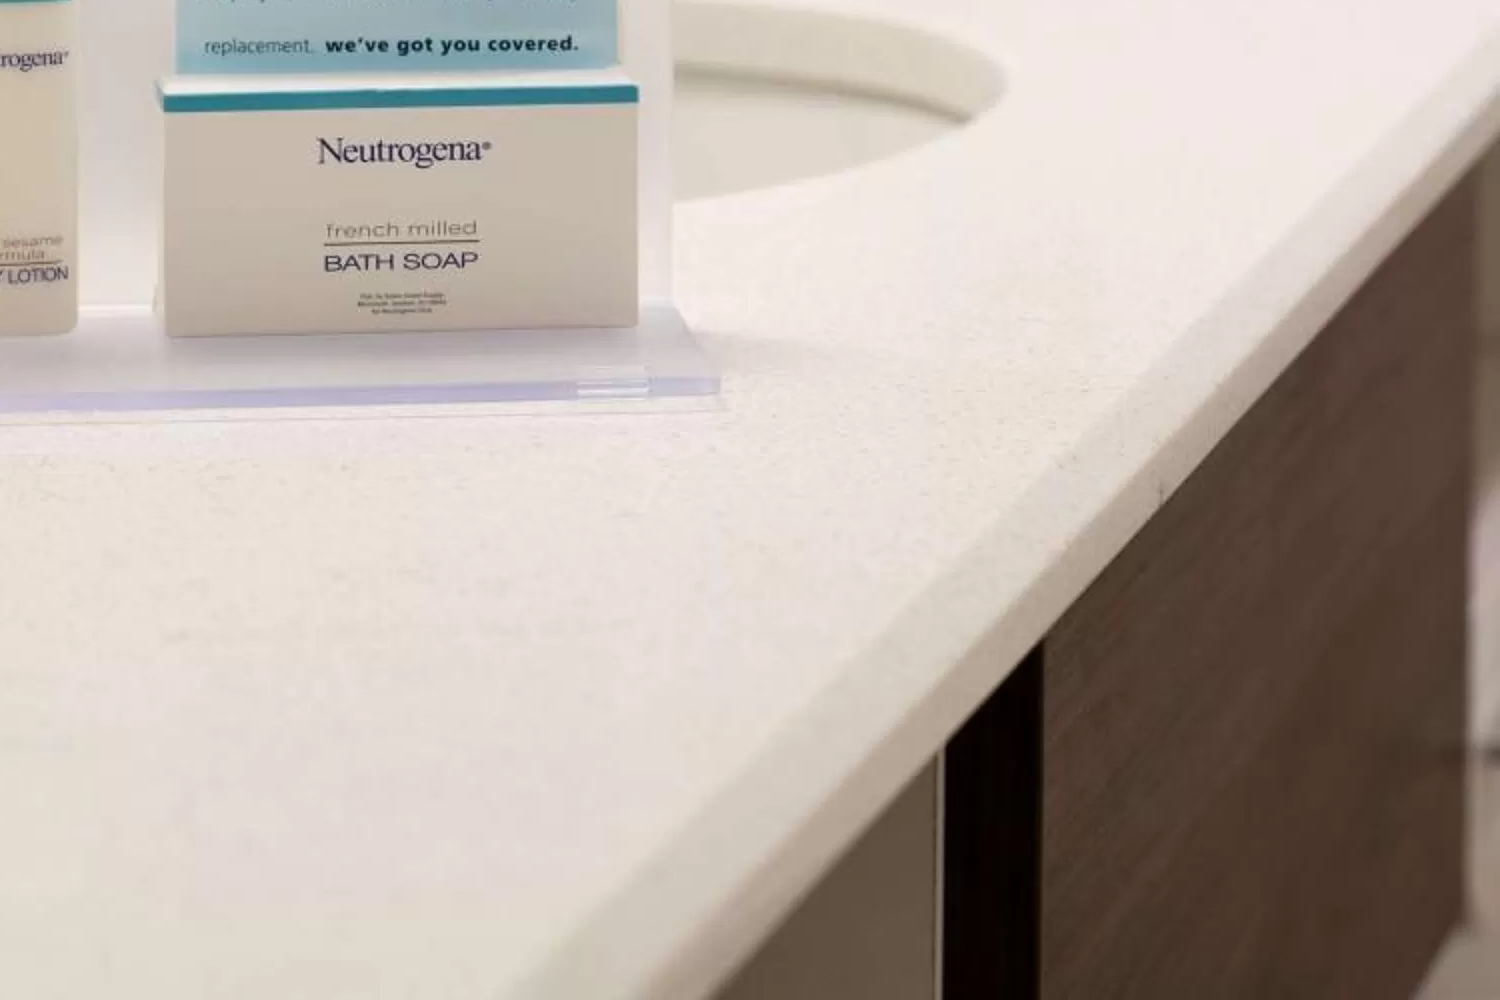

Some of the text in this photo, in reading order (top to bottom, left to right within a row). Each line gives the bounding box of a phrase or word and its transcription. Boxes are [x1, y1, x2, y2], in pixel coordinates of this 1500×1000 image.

[397, 38, 431, 57] got
[440, 39, 480, 56] you
[487, 36, 579, 52] covered.
[326, 220, 477, 239] french milled
[2, 235, 63, 247] sesame
[324, 251, 478, 272] BATH SOAP
[8, 266, 68, 283] LOTION
